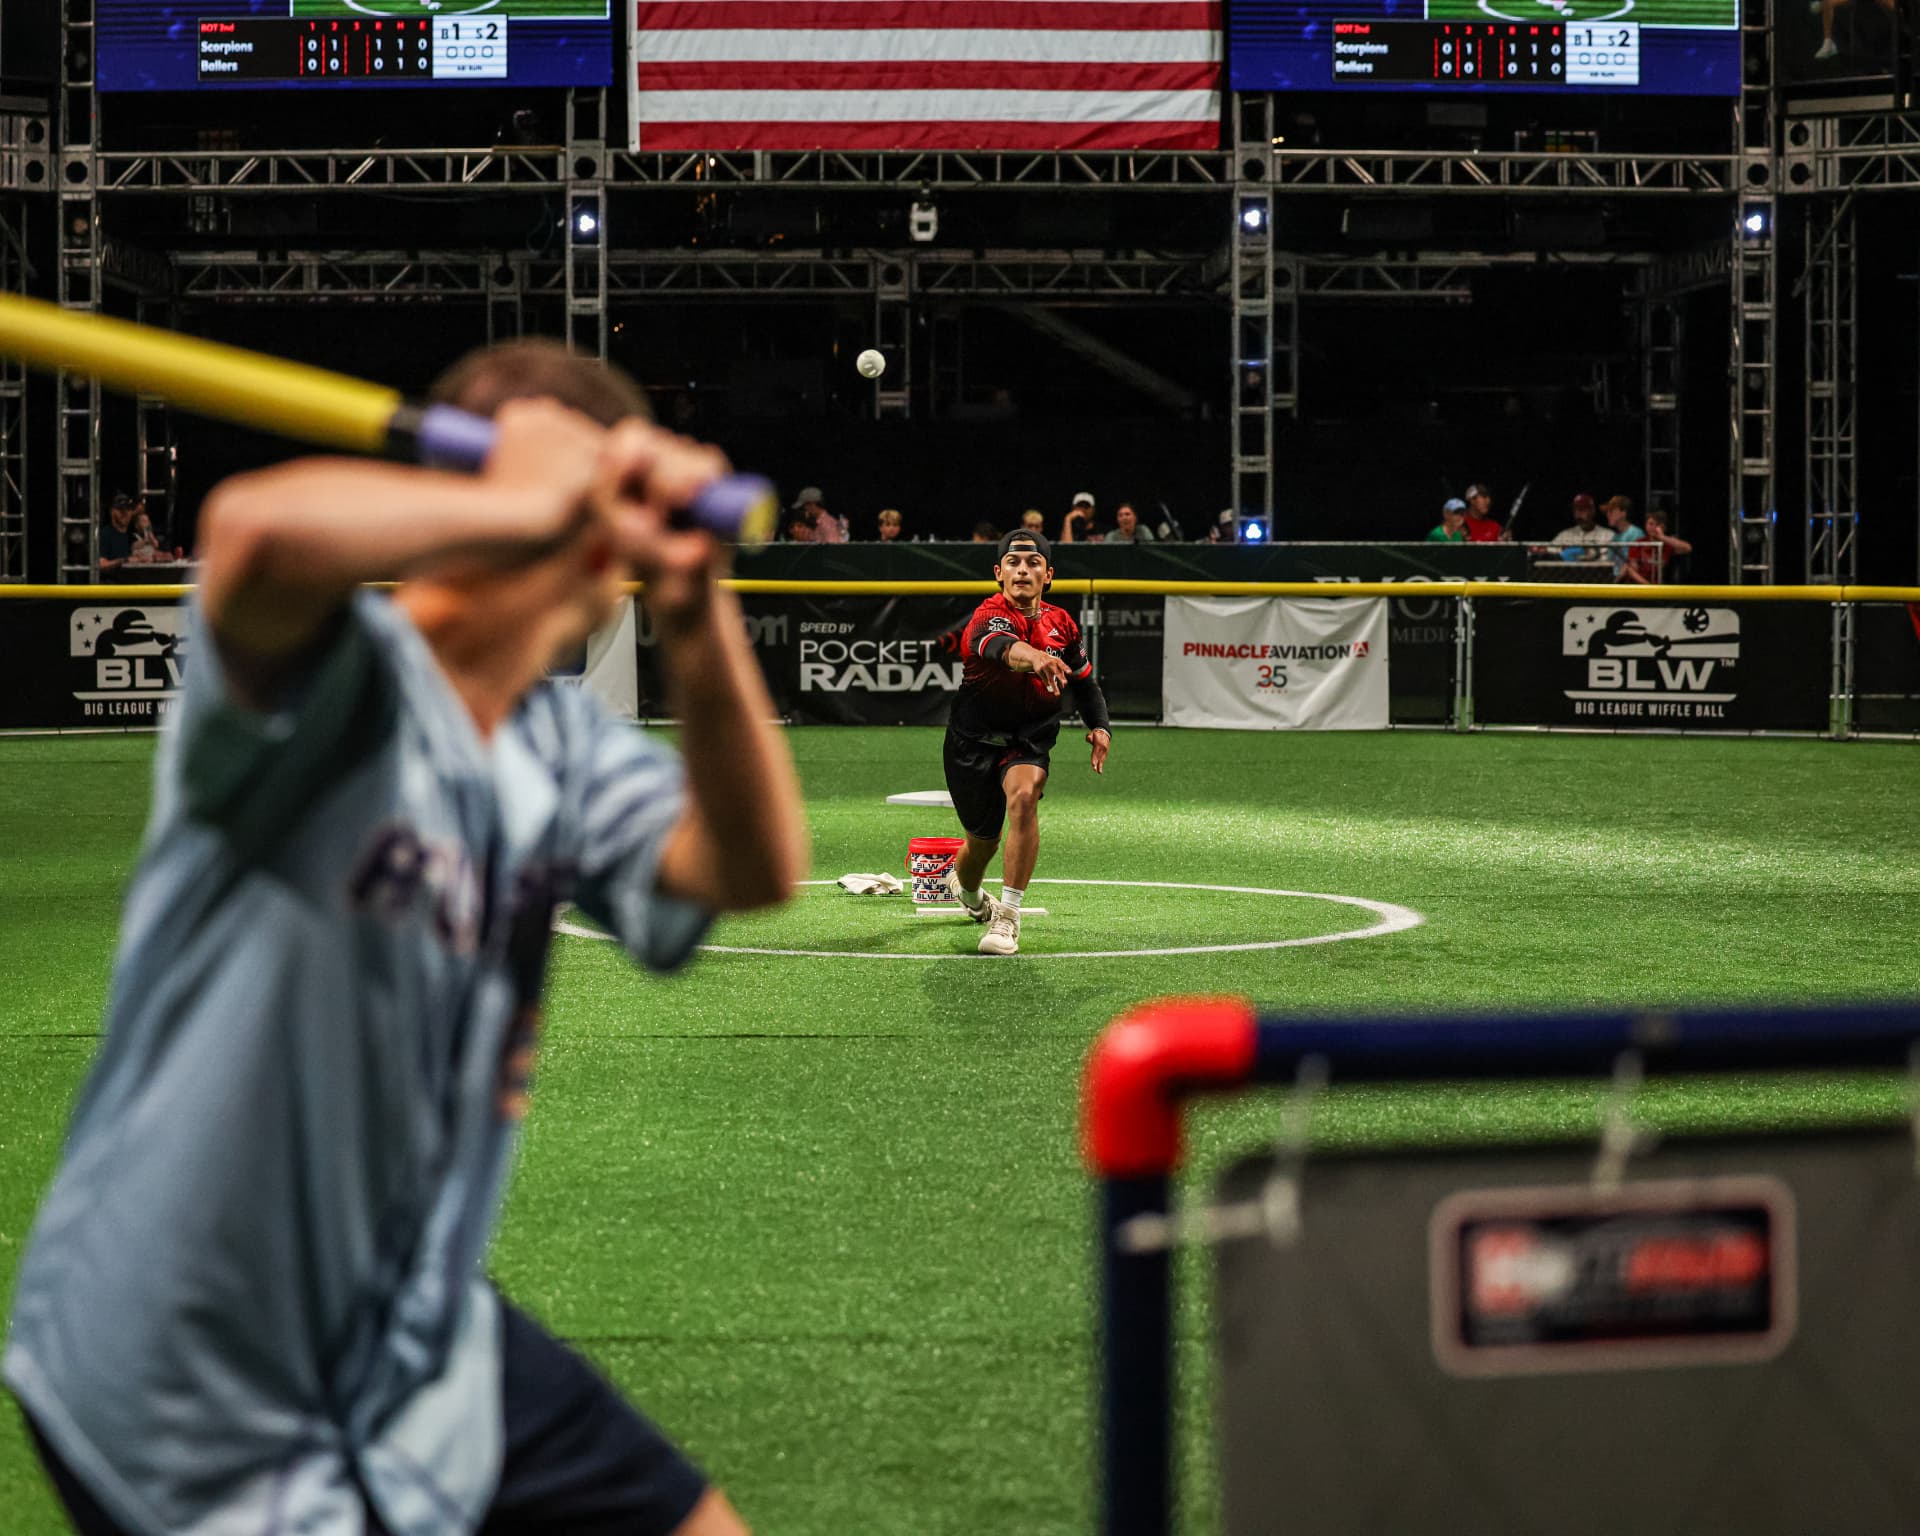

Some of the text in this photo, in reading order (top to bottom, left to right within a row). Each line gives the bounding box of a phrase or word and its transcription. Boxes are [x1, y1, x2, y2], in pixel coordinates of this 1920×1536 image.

[331, 21, 338, 31] 2
[452, 23, 460, 40] 1
[475, 28, 483, 39] S
[486, 23, 498, 40] 2
[1585, 29, 1592, 47] 1
[1618, 30, 1630, 47] 2
[201, 38, 427, 55] Scorpions 0 1 1 1 0
[1442, 42, 1452, 55] 0
[1466, 42, 1472, 55] 1
[1509, 43, 1516, 56] 1
[1531, 43, 1537, 56] 1
[1551, 43, 1561, 56] 0
[308, 58, 317, 71] 0
[330, 58, 339, 71] 0
[374, 57, 384, 70] 0
[397, 57, 403, 70] 1
[418, 57, 427, 70] 0
[1442, 61, 1452, 74] 0
[1464, 61, 1474, 74] 0
[1507, 62, 1517, 75] 0
[1531, 62, 1537, 75] 1
[1551, 62, 1561, 75] 0
[800, 622, 855, 634] SPEED BY
[1392, 627, 1449, 644] MEDI
[800, 640, 937, 664] POCKET
[1257, 665, 1288, 689] 35
[1588, 658, 1715, 690] BLW
[84, 703, 104, 716] BIG
[108, 702, 152, 715] LEAGUE
[1575, 702, 1725, 717] BIG LEAGUE WIFFLE BALL
